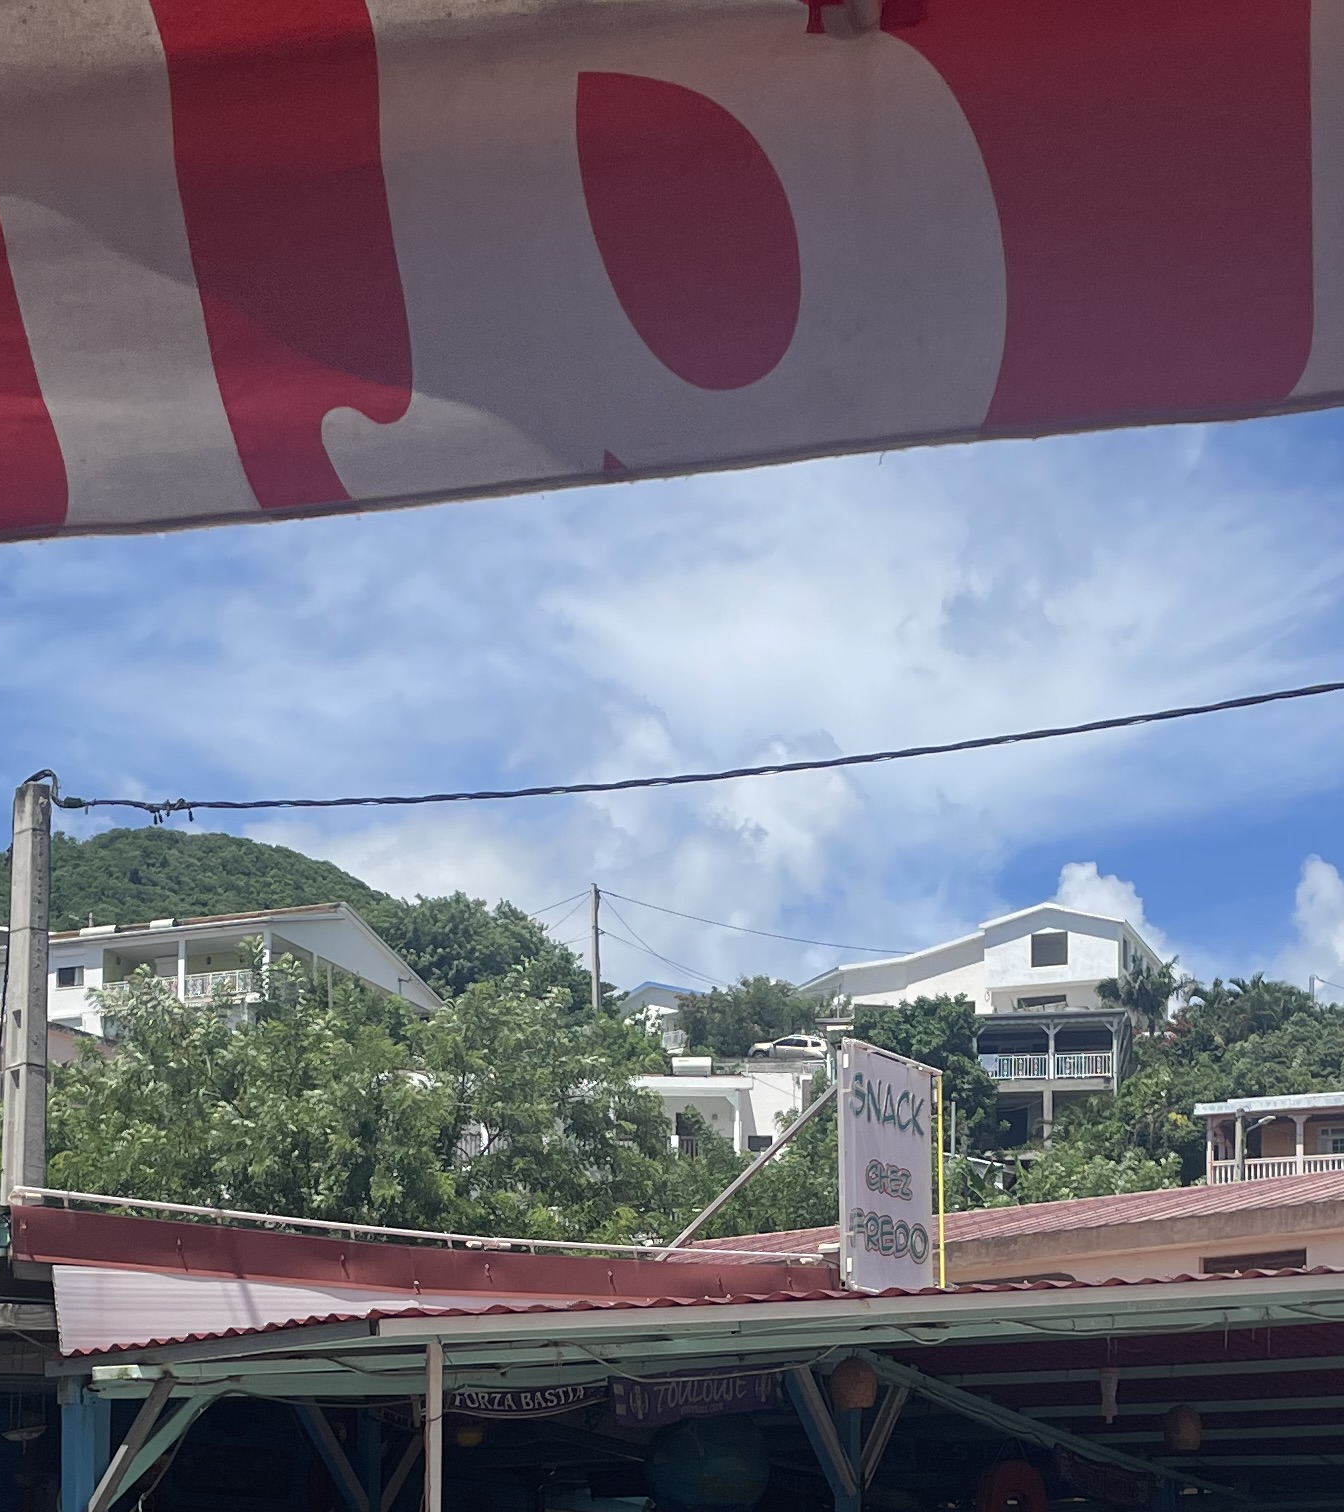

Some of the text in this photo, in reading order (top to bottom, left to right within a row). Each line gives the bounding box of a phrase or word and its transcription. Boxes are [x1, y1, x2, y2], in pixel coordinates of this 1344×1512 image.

[849, 1072, 924, 1138] SNACK
[865, 1159, 913, 1201] CHEZ
[850, 1207, 929, 1265] FREDO
[454, 1387, 586, 1410] FORZA BASTIA
